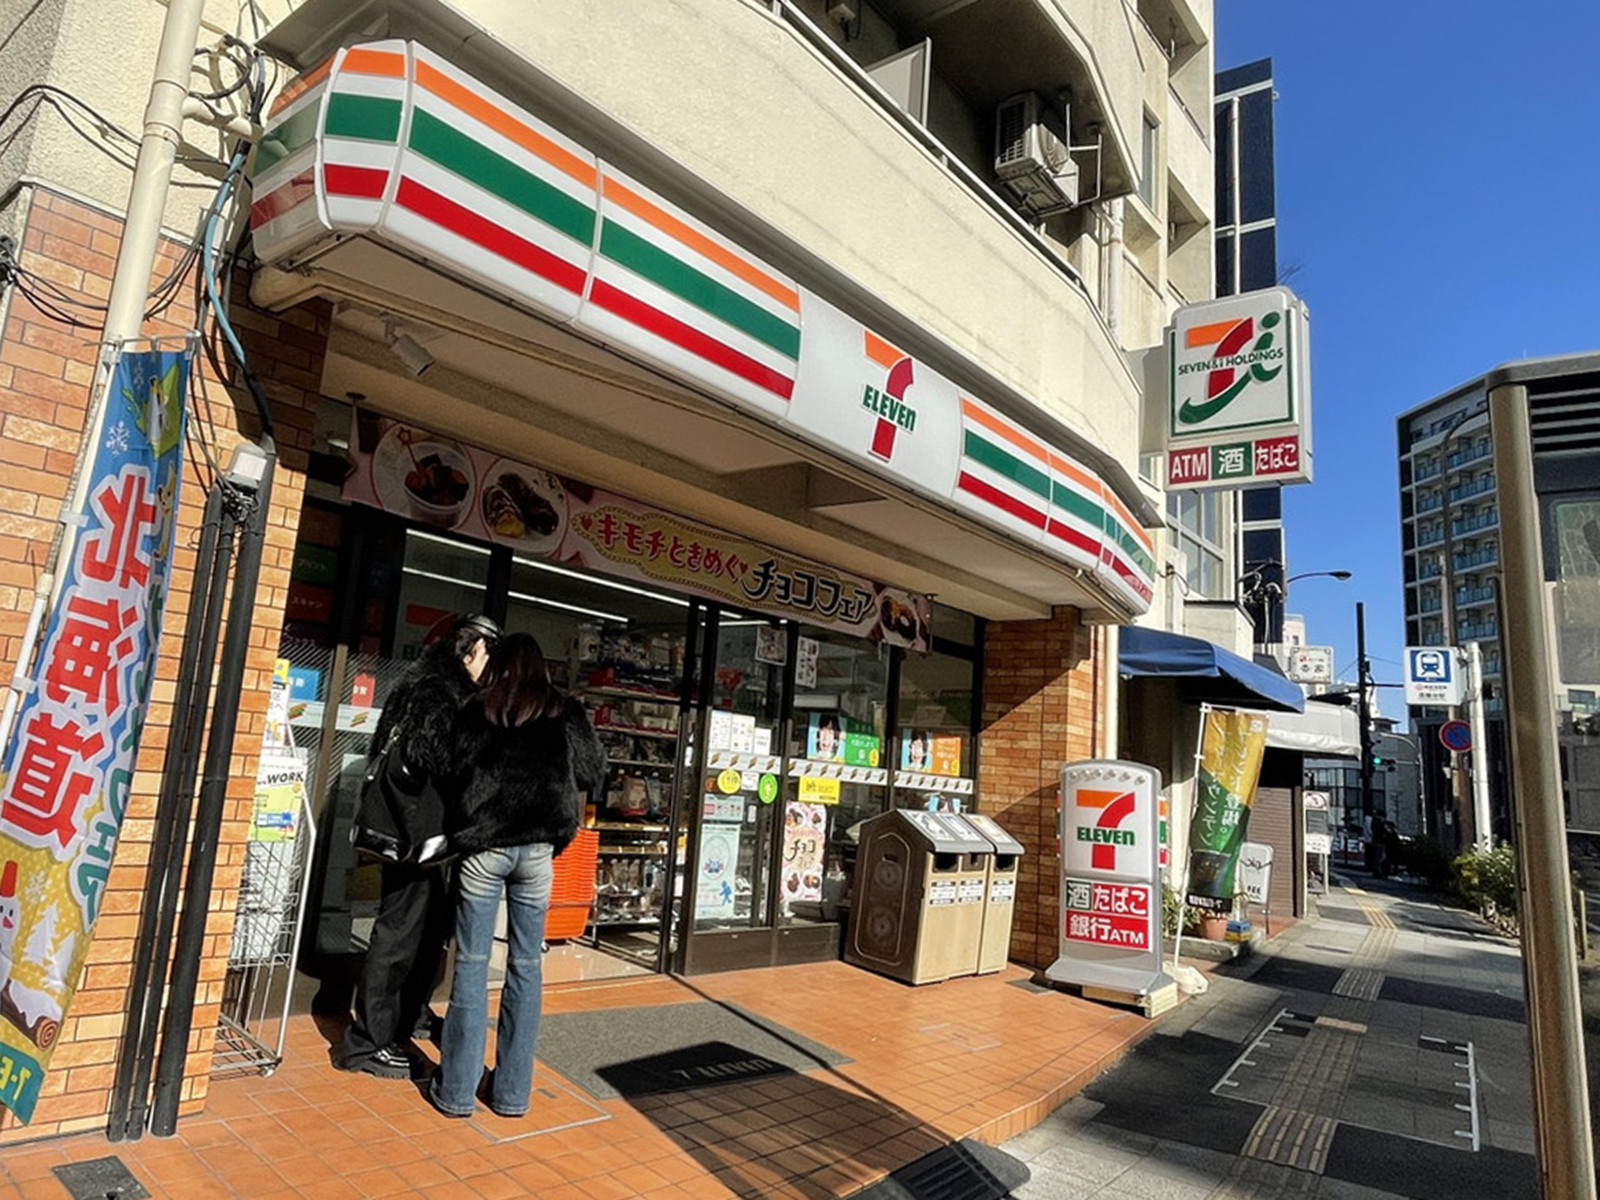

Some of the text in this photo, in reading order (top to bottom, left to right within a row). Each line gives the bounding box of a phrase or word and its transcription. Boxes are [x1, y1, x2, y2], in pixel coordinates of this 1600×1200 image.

[1225, 347, 1284, 366] HOLDINGS
[1171, 450, 1207, 479] ATM
[1218, 447, 1245, 475] 酒
[1256, 443, 1297, 470] たばこ
[597, 513, 739, 582] キモチときめく
[741, 557, 874, 622] チョコフェア
[1068, 882, 1090, 908] 酒
[1094, 885, 1147, 915] たばこ
[1070, 914, 1145, 945] 銀行ATM
